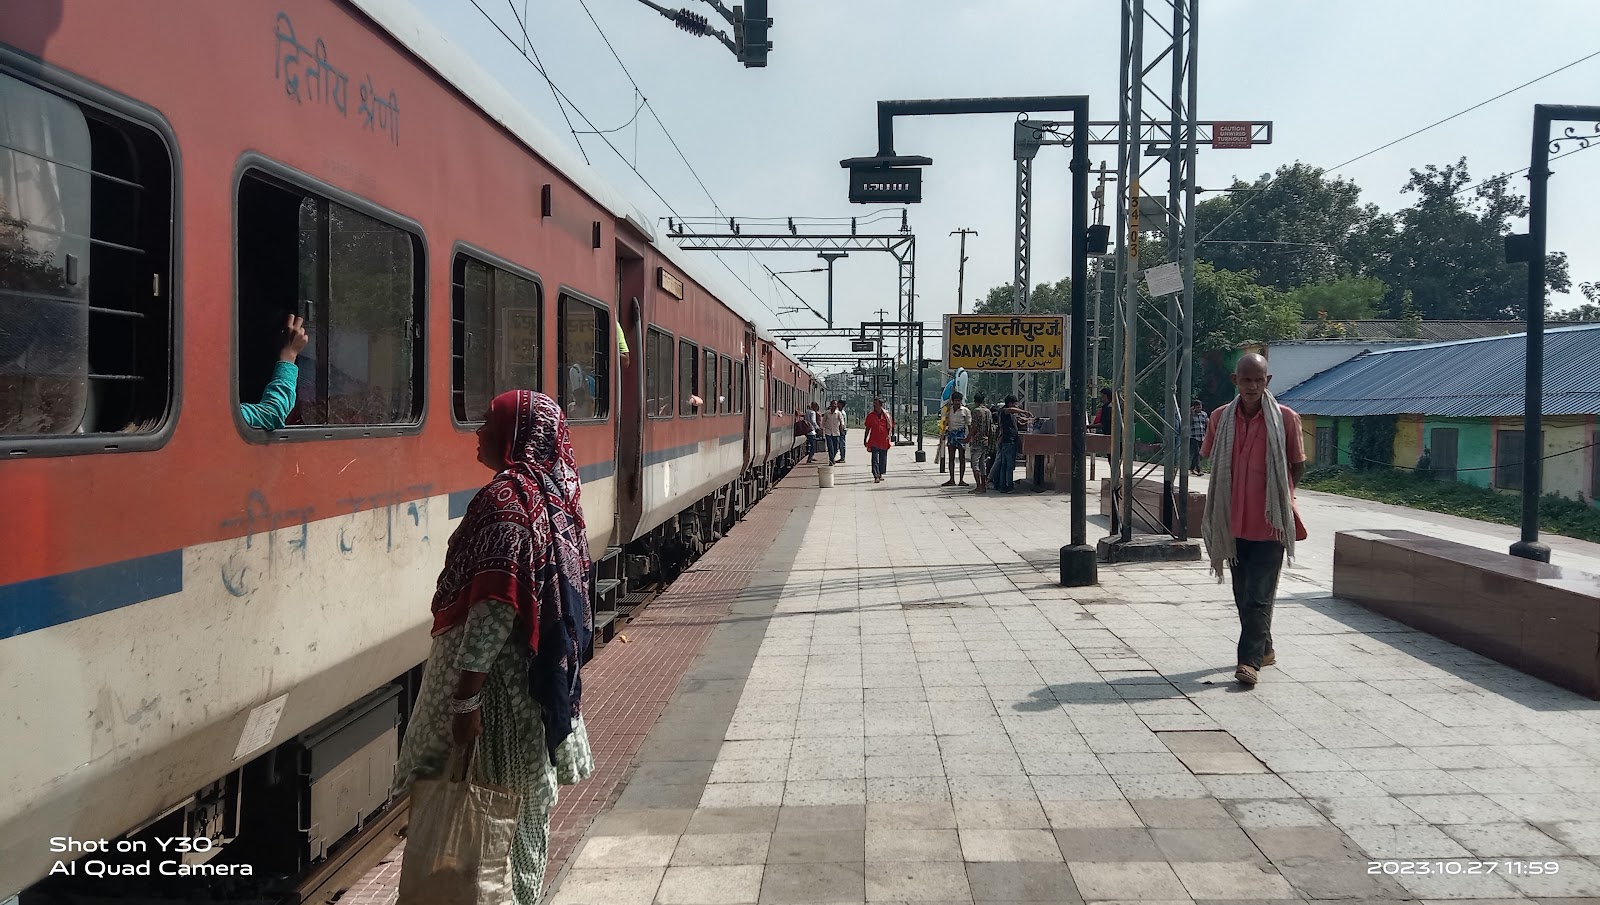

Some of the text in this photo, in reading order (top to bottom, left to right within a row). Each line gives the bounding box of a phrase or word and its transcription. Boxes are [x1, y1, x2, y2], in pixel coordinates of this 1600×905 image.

[274, 11, 348, 118] द्वितीय
[954, 318, 1045, 342] समस्तीपुर
[952, 344, 1045, 358] SAMASTIPUR
